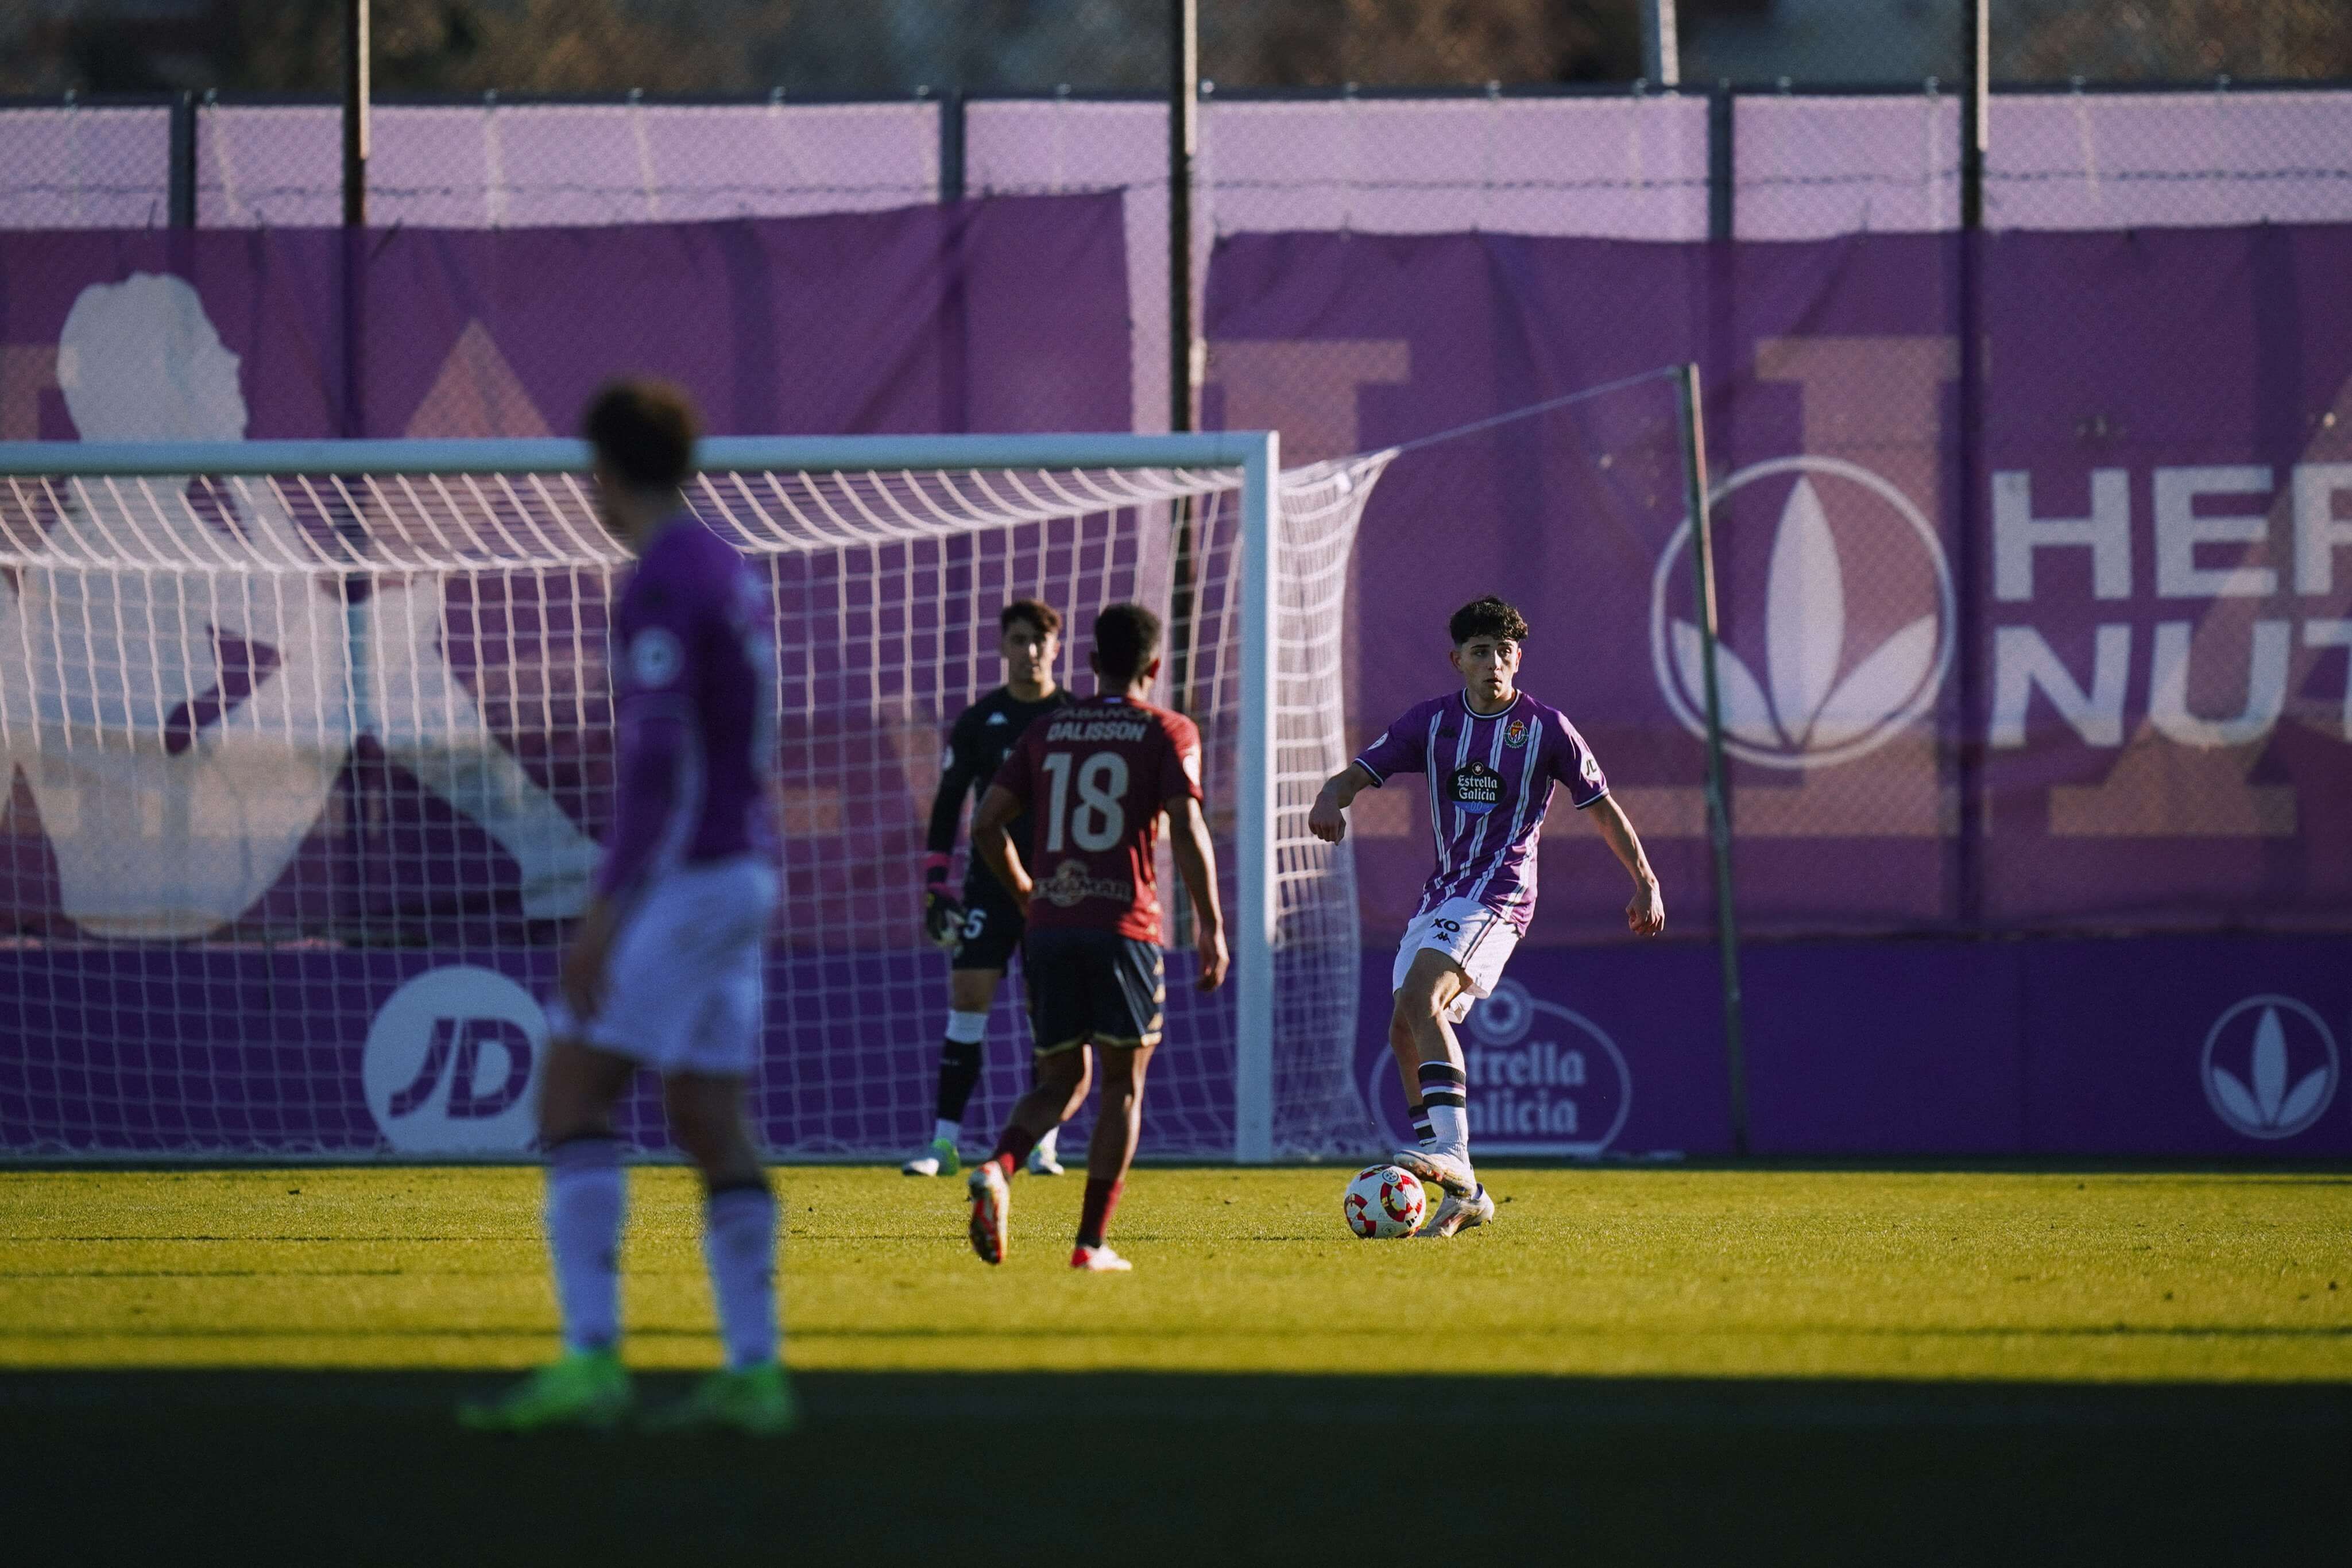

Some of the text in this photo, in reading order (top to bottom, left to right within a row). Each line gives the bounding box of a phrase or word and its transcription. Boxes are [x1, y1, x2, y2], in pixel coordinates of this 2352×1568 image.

[1041, 751, 1129, 853] 18
[1457, 775, 1498, 789] Estrella
[1459, 785, 1496, 801] Galicia
[1429, 918, 1461, 933] XO
[389, 1017, 533, 1120] JD
[1466, 1041, 1587, 1086] trella
[1467, 1089, 1579, 1135] alicia
